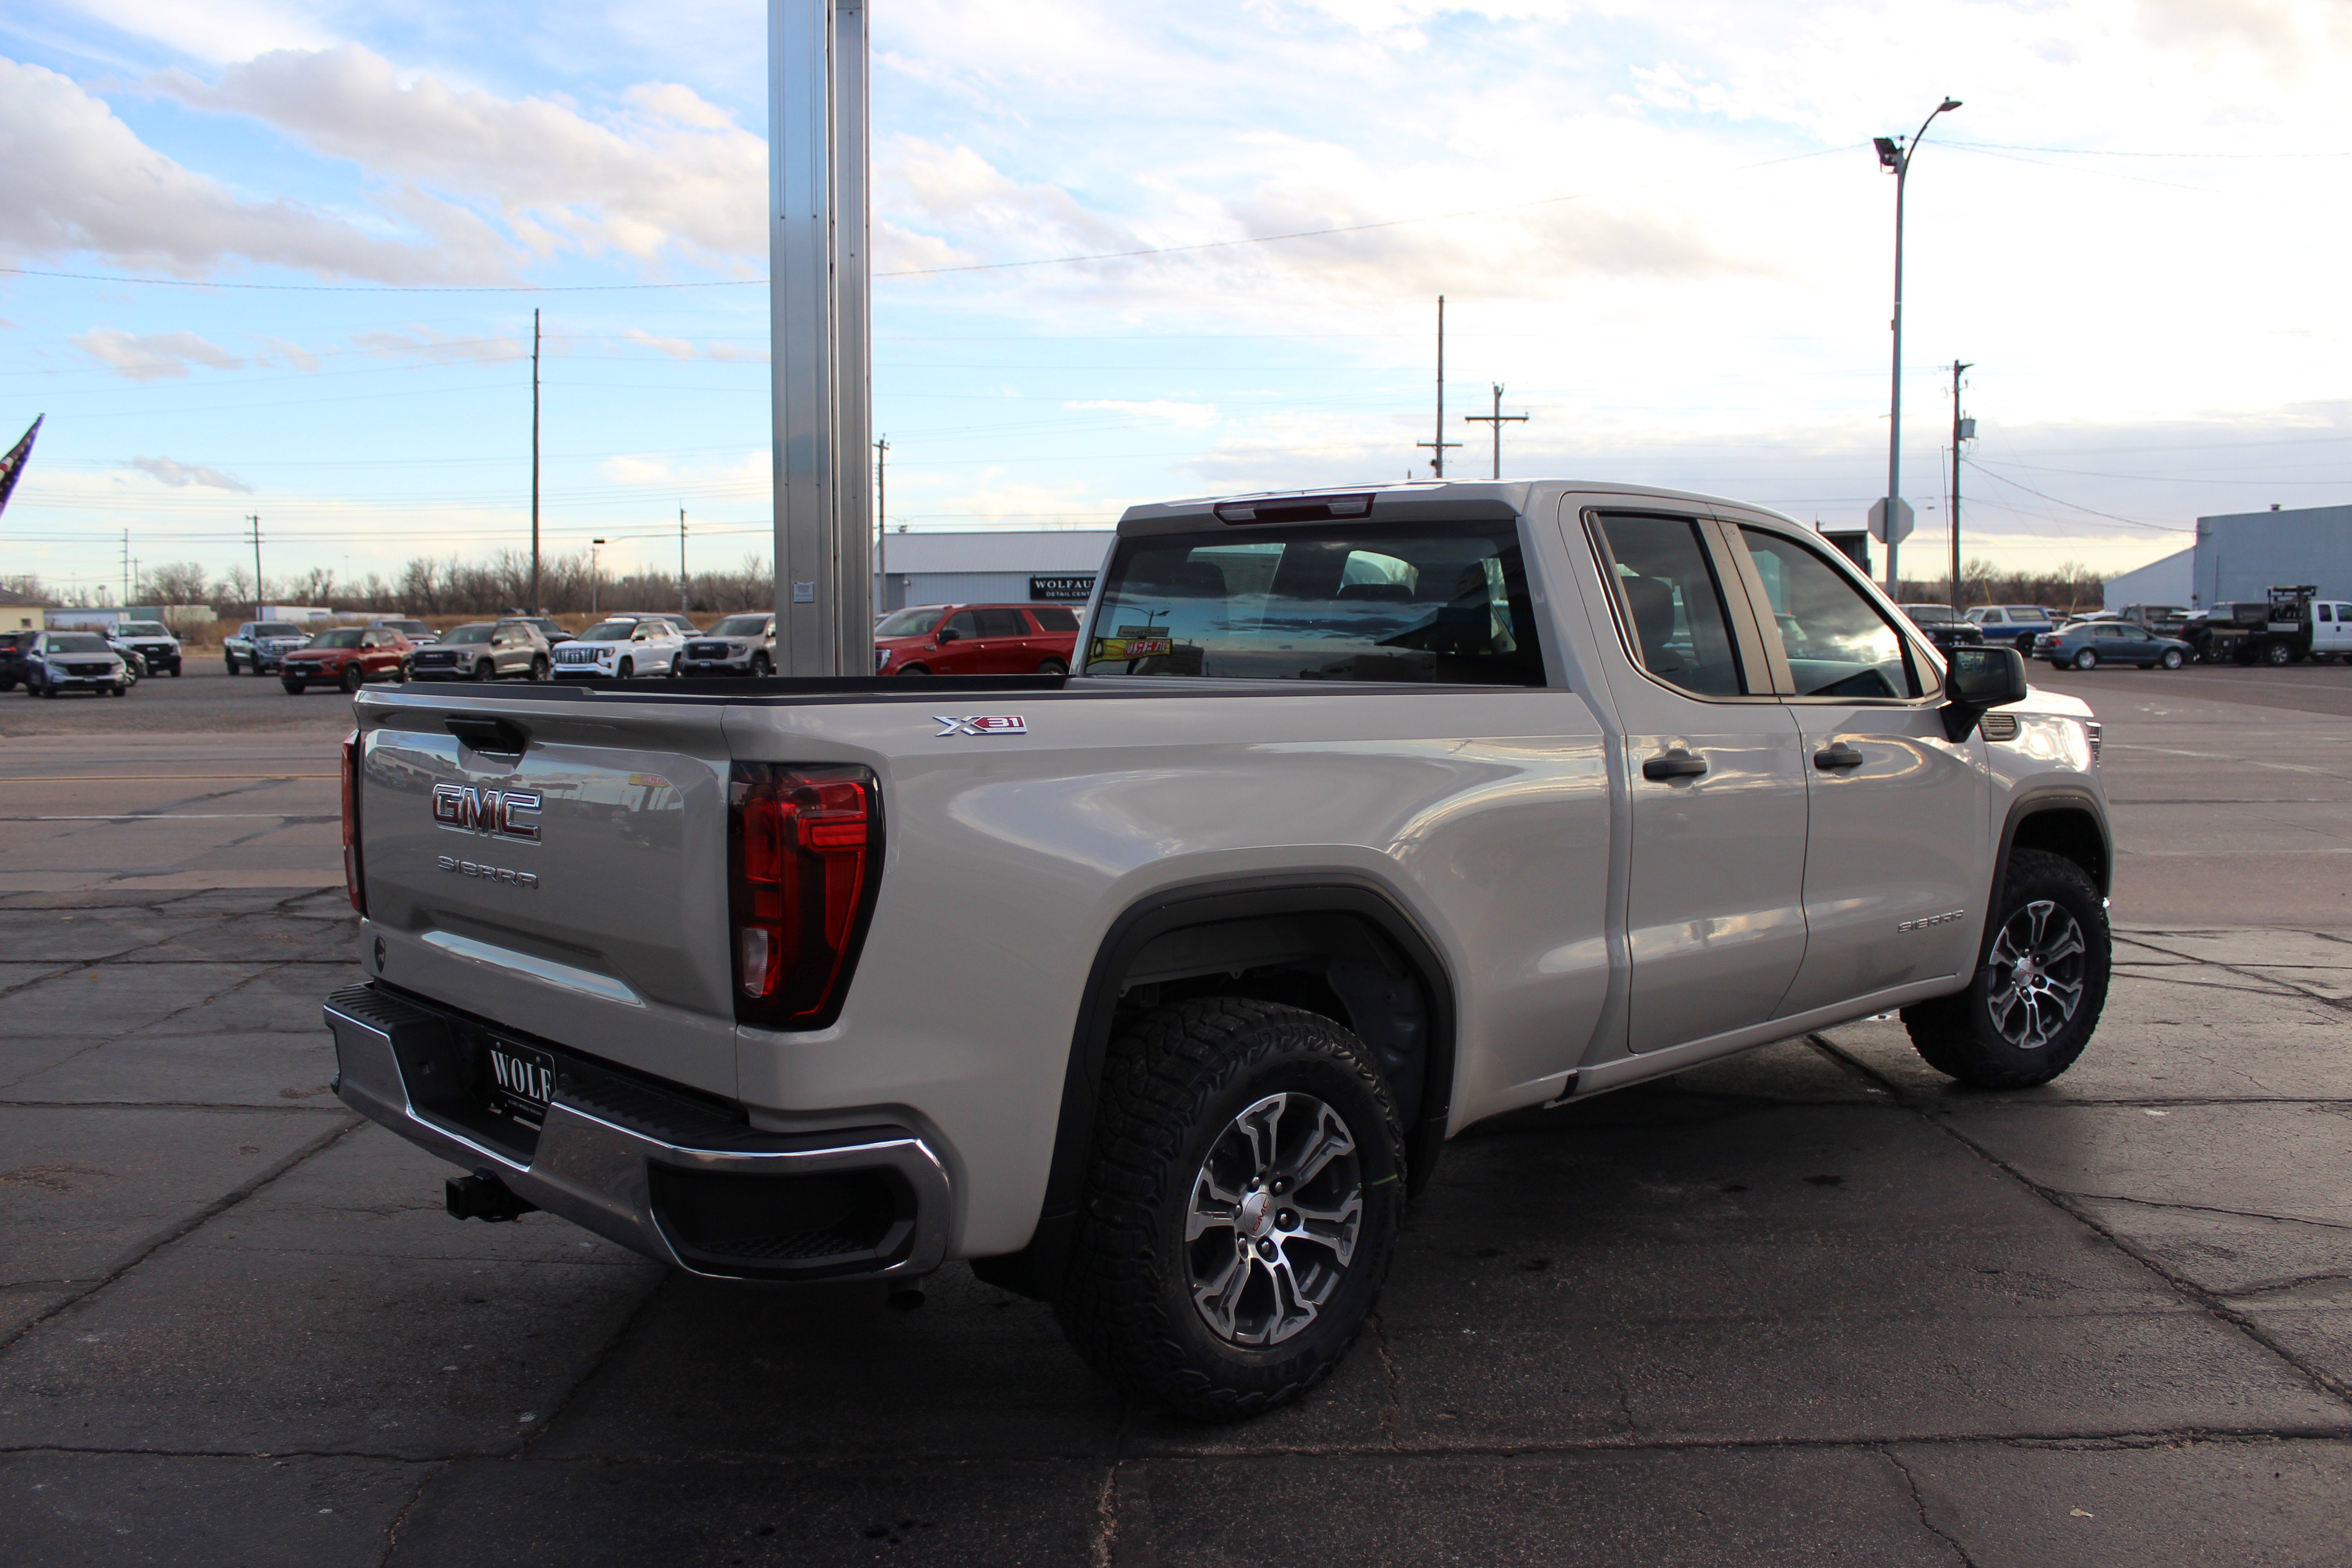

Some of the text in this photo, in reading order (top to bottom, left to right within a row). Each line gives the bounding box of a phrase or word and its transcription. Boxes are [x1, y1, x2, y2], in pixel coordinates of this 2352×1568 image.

[1035, 580, 1095, 588] WOLFAU
[433, 782, 542, 844] GMC
[438, 855, 539, 890] SIERRA
[1898, 909, 1964, 932] SIERRA
[490, 1049, 551, 1103] WOLF
[1252, 1197, 1270, 1232] GMC
